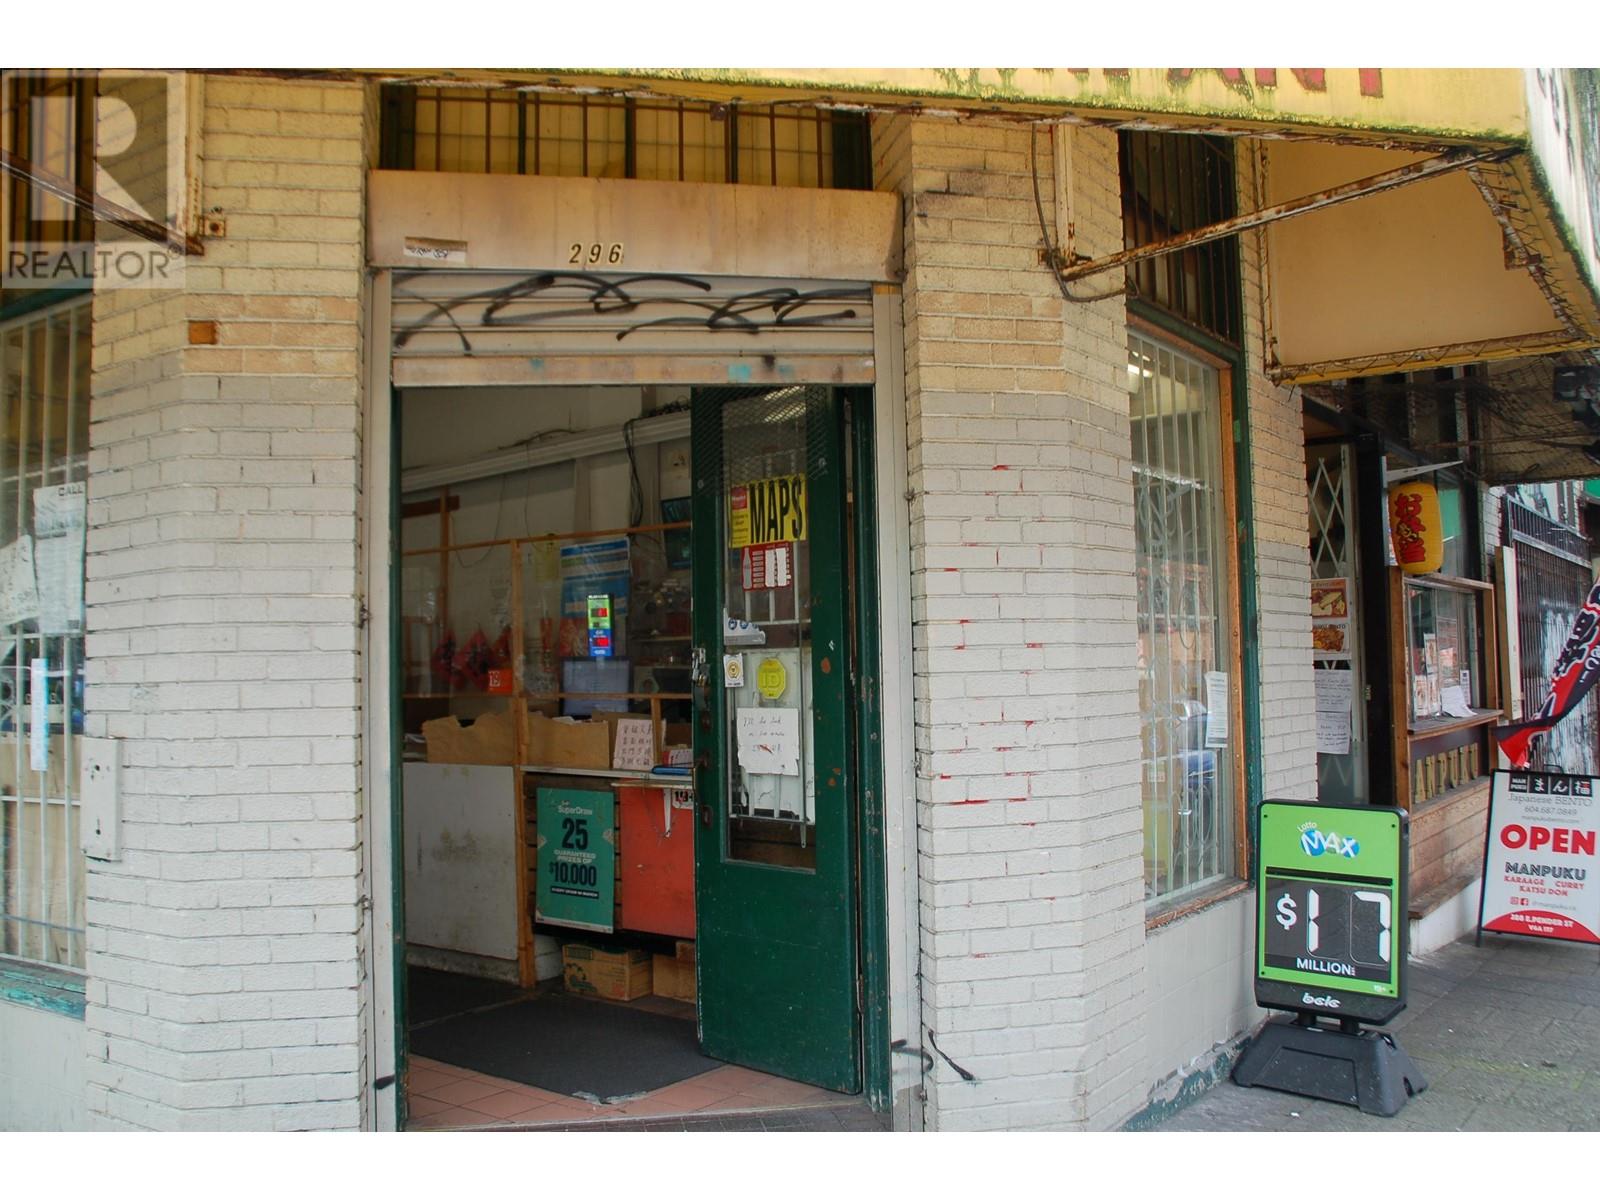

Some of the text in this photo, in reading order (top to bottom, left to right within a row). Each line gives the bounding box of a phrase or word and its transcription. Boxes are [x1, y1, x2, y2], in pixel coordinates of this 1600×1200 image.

[568, 243, 622, 264] 296
[747, 476, 804, 544] MAPS
[1508, 793, 1593, 807] Japanese BENTO
[557, 805, 593, 816] SuperDraw
[561, 817, 589, 850] 25
[1296, 821, 1318, 833] Lotto
[1301, 830, 1357, 859] MAX
[1500, 823, 1596, 856] OPEN
[1504, 861, 1587, 881] MANPUKU
[1503, 875, 1585, 890] KARAAGE CURRY
[1519, 885, 1569, 897] KATSU DON
[1296, 957, 1351, 975] MILLION
